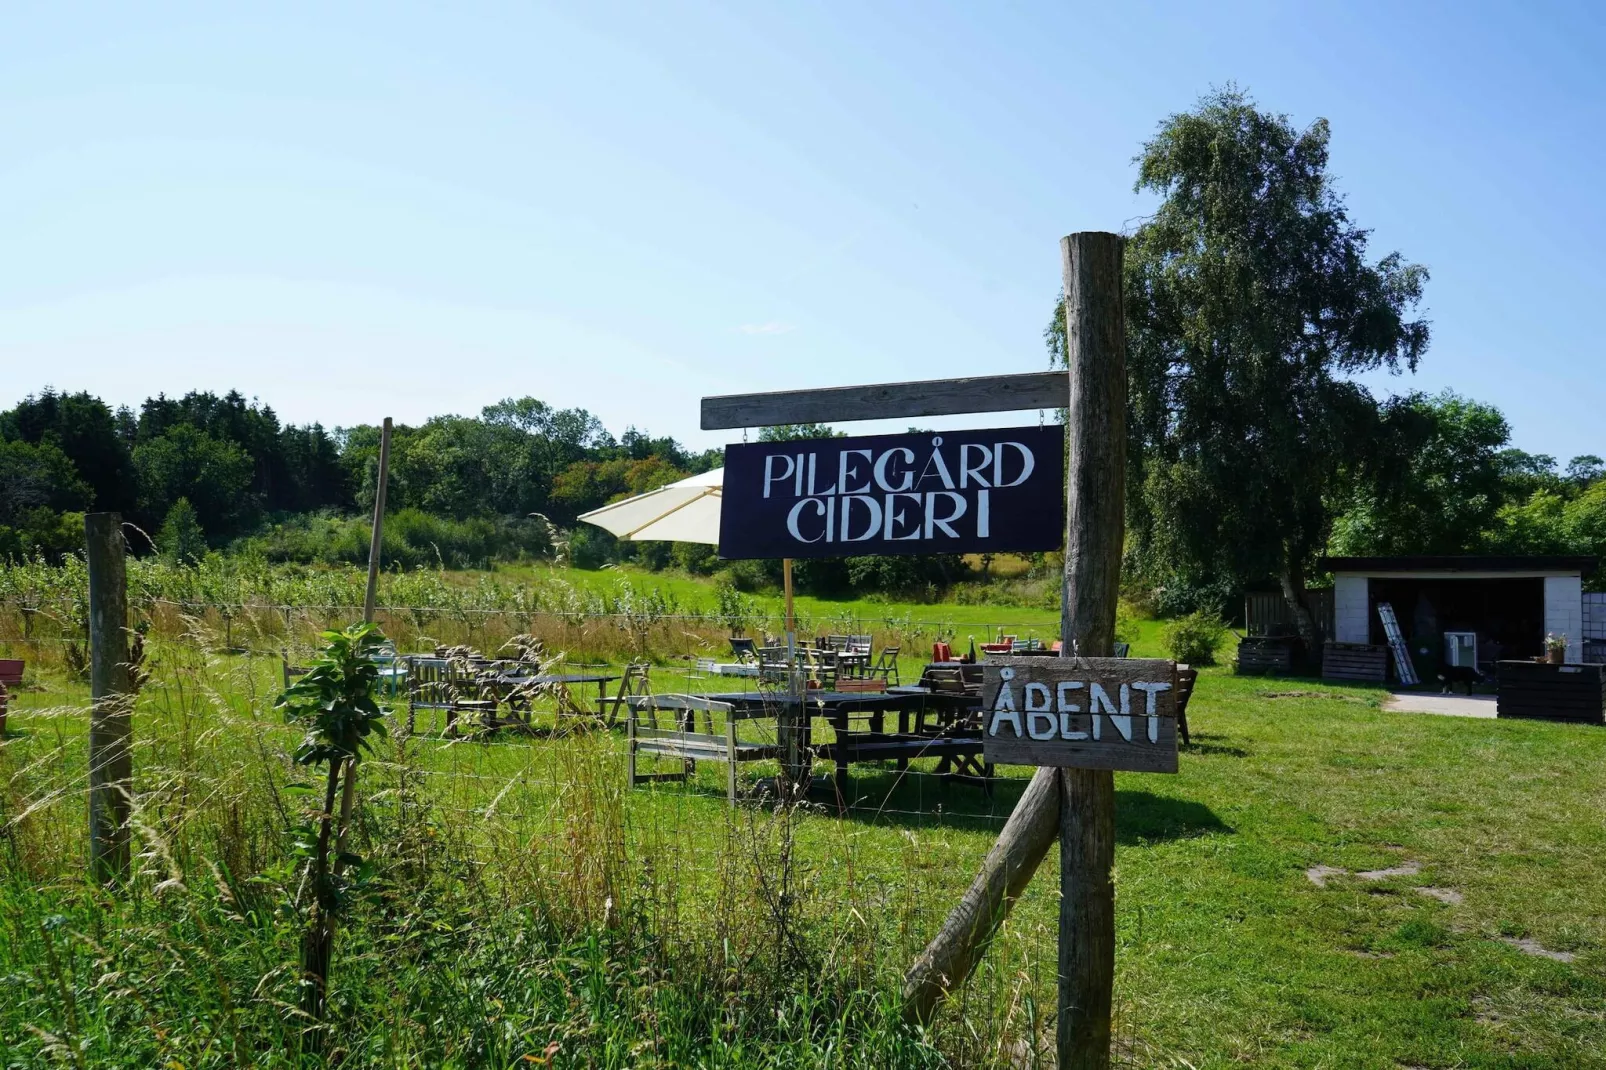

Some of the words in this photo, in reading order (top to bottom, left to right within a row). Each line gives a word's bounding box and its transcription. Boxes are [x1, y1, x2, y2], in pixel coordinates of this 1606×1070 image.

[763, 436, 1035, 499] PILEGÅRD
[786, 489, 990, 543] CIDERI
[988, 667, 1172, 744] ÅBENT
